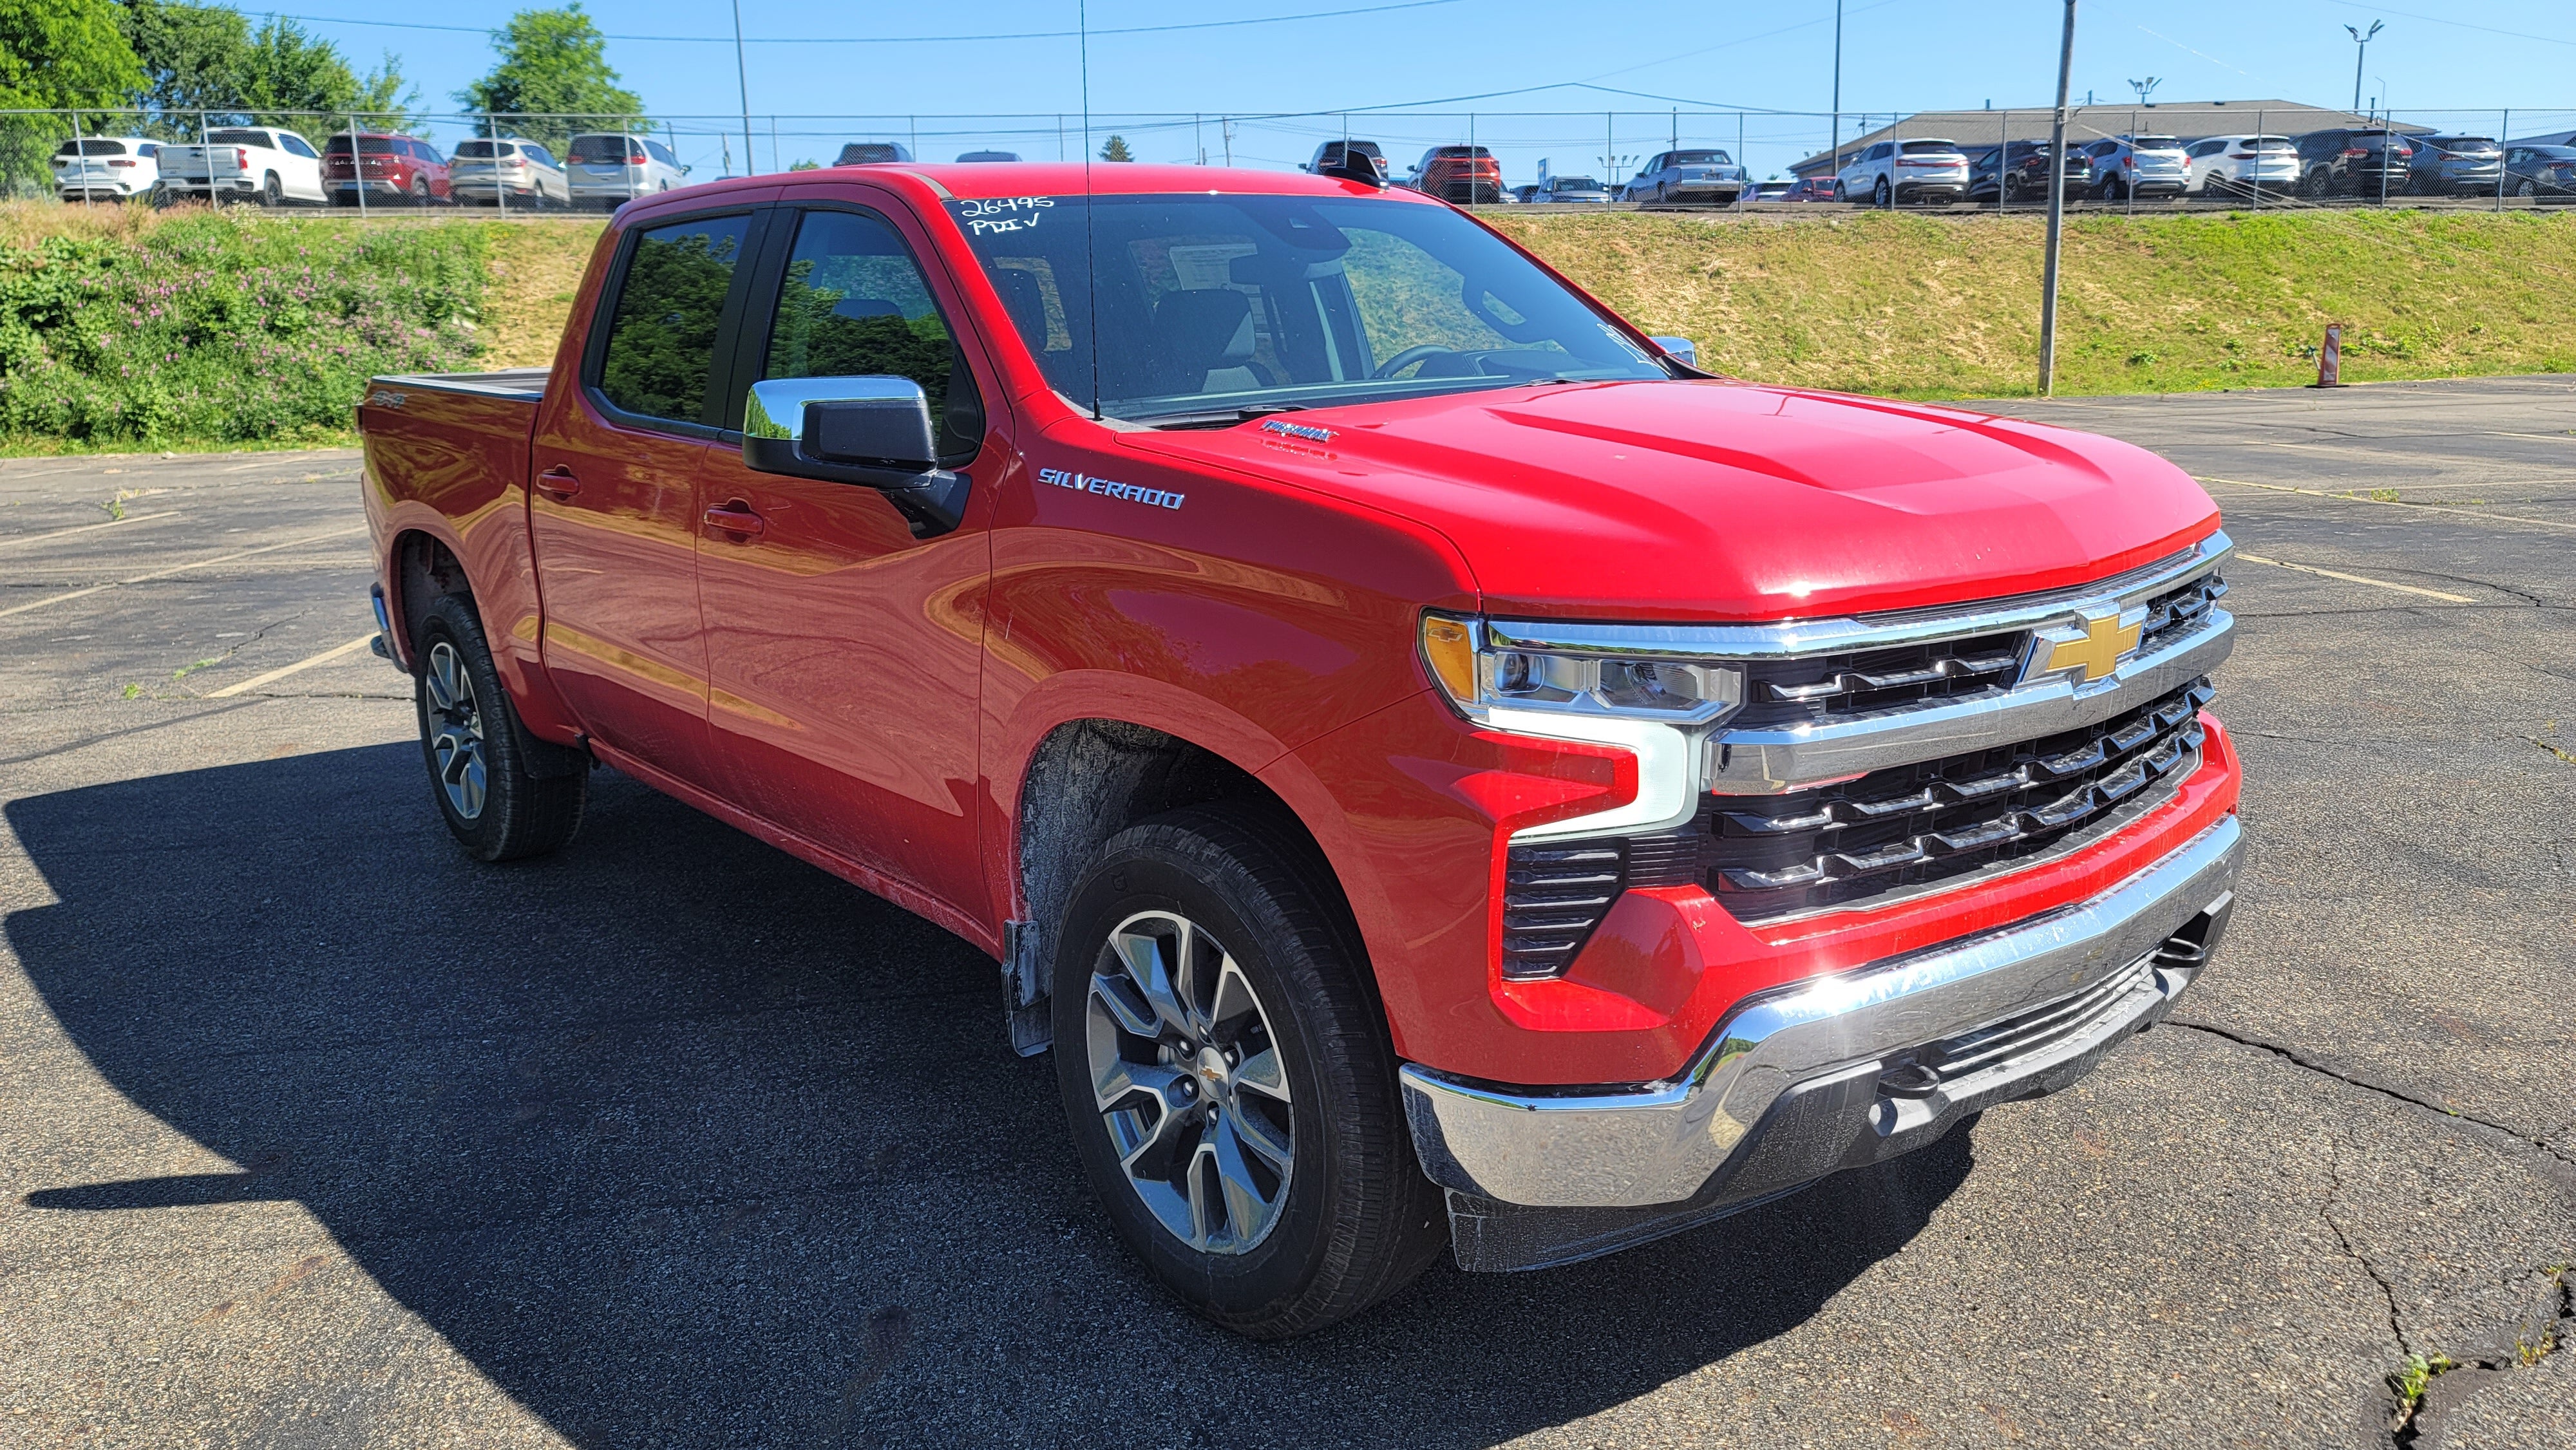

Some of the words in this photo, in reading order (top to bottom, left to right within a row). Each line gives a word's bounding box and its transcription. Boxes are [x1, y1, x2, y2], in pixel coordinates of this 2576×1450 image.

[960, 196, 1055, 217] 26495
[967, 218, 1023, 236] PDI
[1037, 467, 1185, 511] SILVERADO
